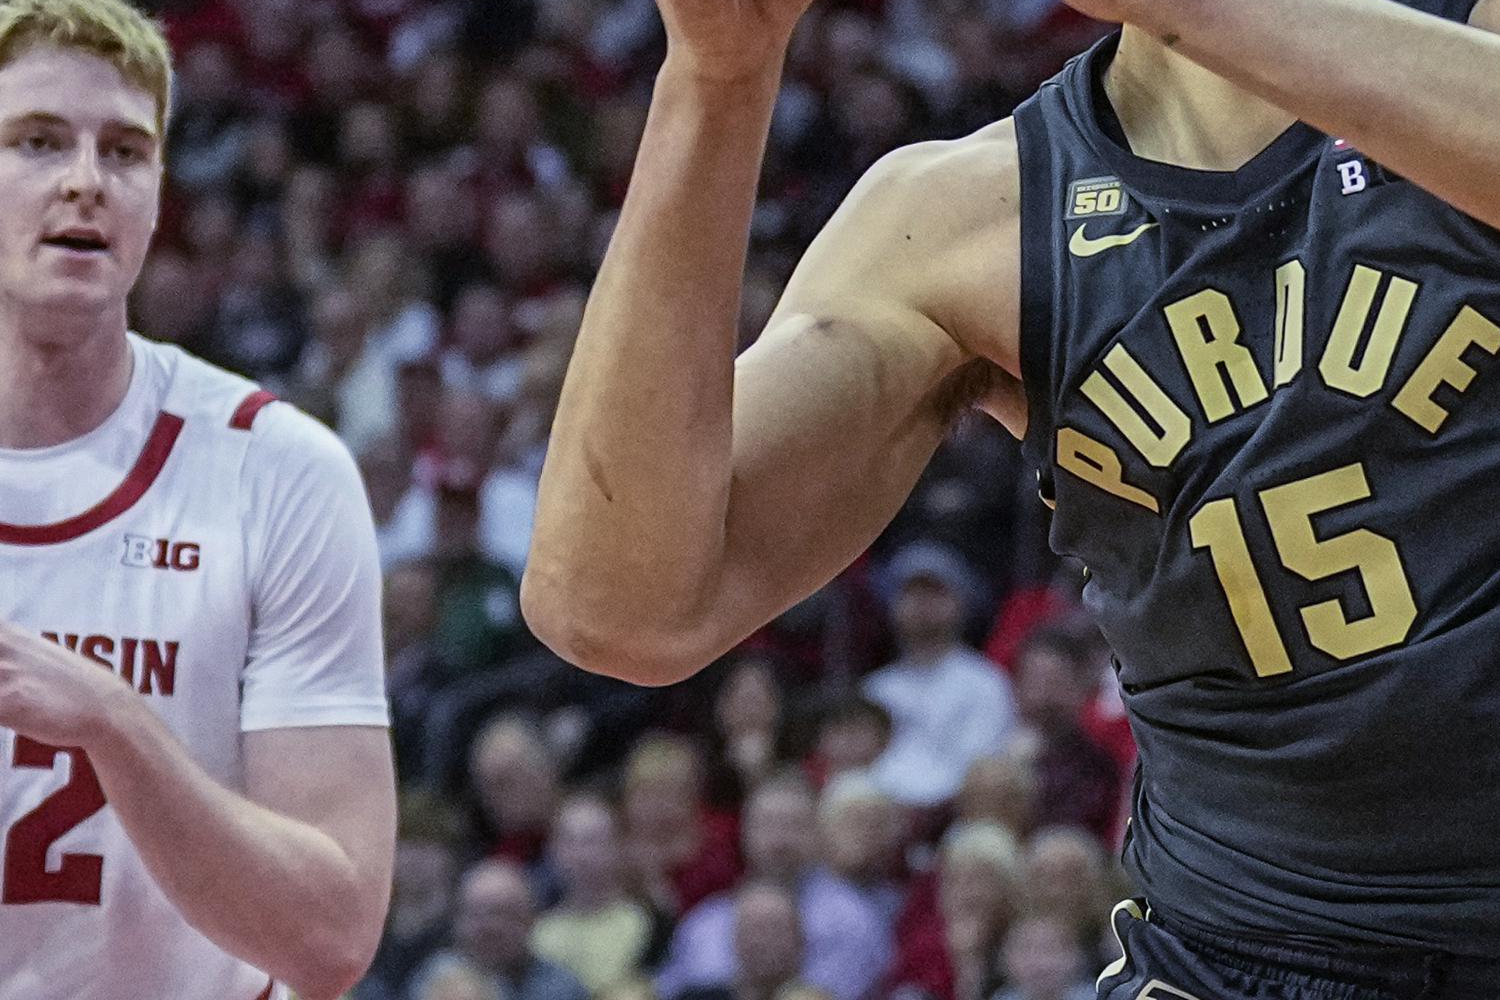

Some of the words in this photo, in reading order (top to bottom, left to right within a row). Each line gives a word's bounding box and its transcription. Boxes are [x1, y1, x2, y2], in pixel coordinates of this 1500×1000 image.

[1073, 188, 1121, 215] 50
[120, 533, 200, 571] BIG
[1188, 462, 1419, 679] 15
